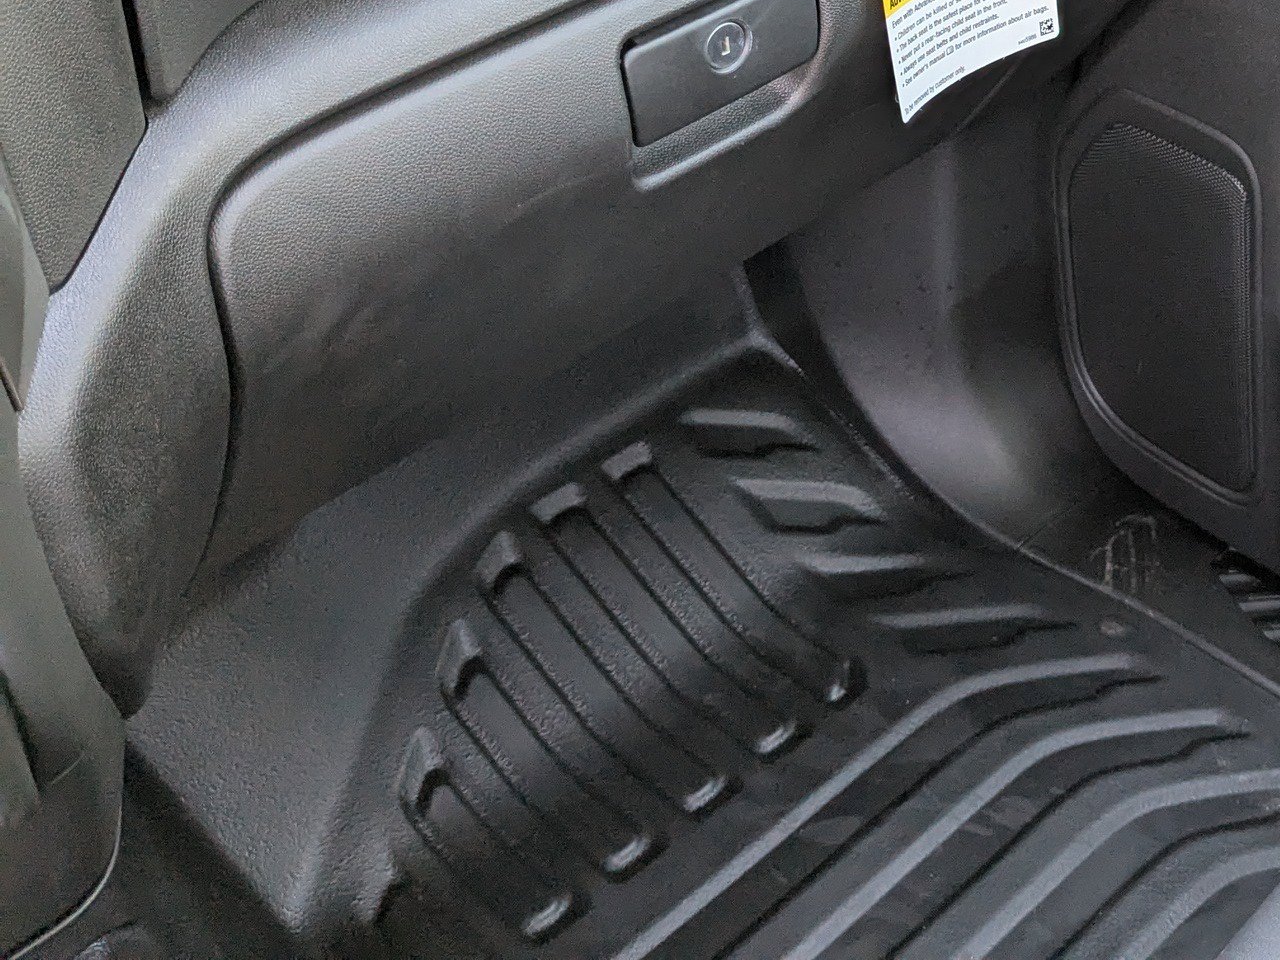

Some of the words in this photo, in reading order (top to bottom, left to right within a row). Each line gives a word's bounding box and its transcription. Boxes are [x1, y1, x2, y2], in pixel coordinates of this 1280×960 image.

[892, 15, 903, 29] Even
[903, 8, 914, 19] with
[898, 22, 916, 40] Children
[916, 16, 925, 26] can
[932, 4, 948, 16] killed
[907, 34, 918, 44] back
[918, 26, 928, 38] seat
[934, 18, 942, 27] the
[942, 9, 958, 22] safest
[959, 2, 973, 15] place
[952, 18, 964, 29] child
[964, 12, 976, 22] seat
[982, 4, 992, 12] the
[903, 60, 918, 74] Always
[926, 46, 936, 56] seat
[936, 38, 948, 48] belts
[949, 32, 958, 42] and
[959, 24, 972, 36] child
[972, 13, 1000, 30] restraints.
[904, 76, 912, 86] See
[929, 52, 946, 67] manual
[954, 42, 962, 50] for
[977, 22, 1008, 39] information
[1008, 13, 1024, 26] about
[1024, 10, 1032, 18] air
[934, 72, 954, 88] customer
